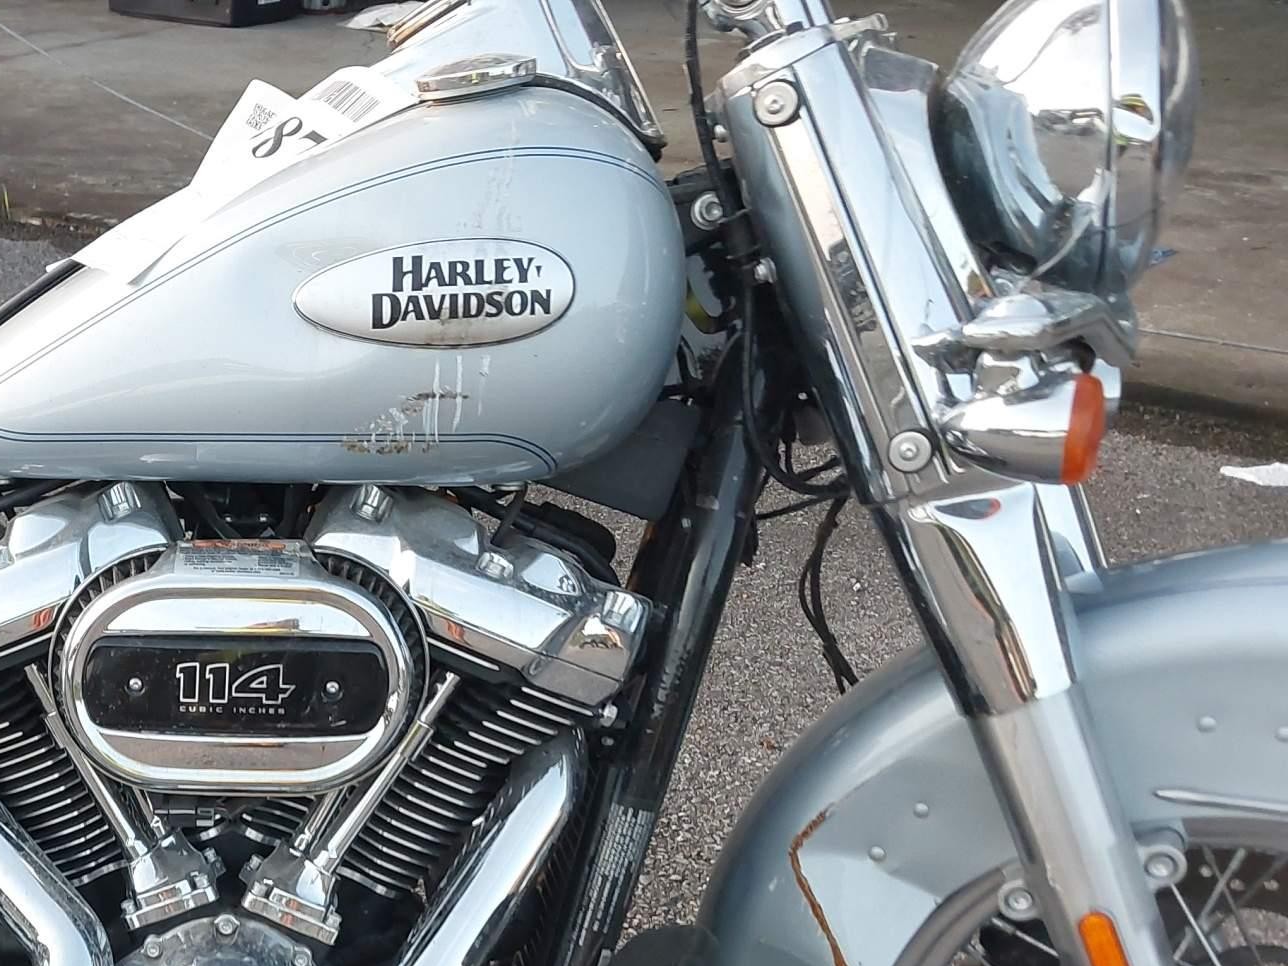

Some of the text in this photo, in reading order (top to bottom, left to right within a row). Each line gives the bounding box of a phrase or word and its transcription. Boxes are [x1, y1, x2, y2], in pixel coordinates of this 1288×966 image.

[371, 289, 553, 330] DAVIDSON
[175, 662, 296, 705] 114
[179, 705, 285, 715] CUBIC INCHES
